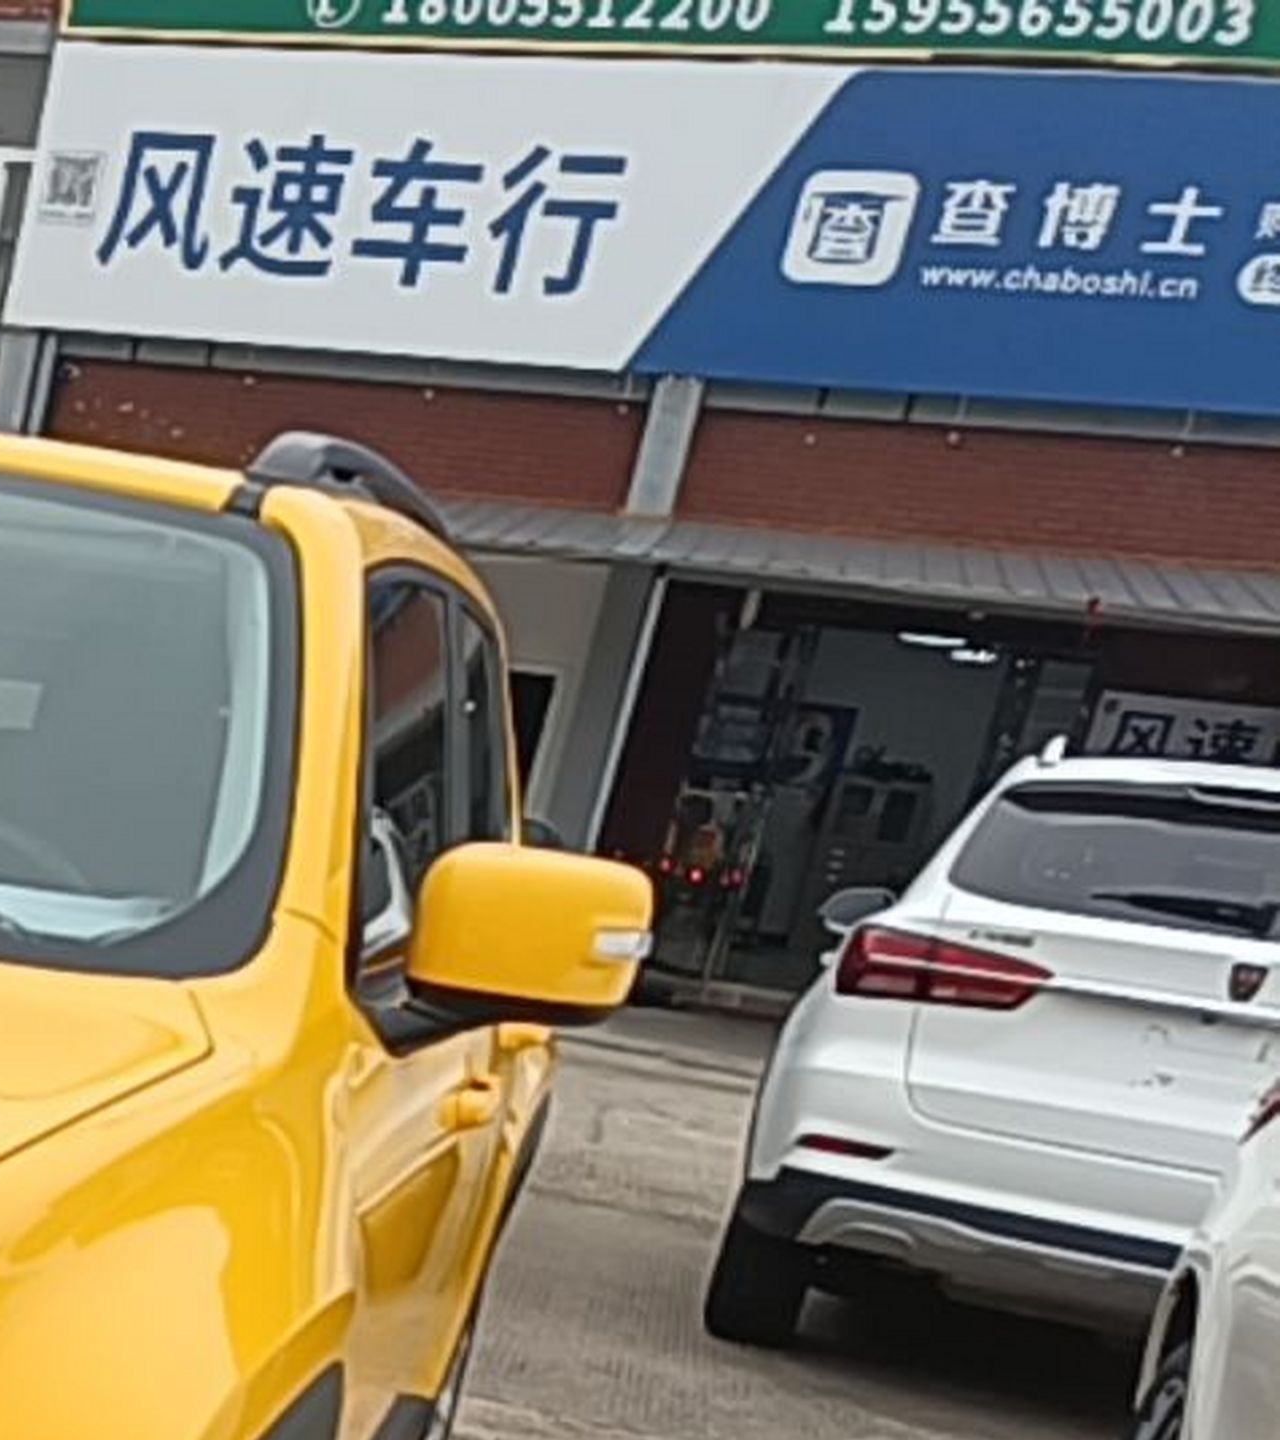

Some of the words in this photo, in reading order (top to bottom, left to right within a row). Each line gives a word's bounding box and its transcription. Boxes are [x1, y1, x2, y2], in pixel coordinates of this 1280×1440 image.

[822, 0, 1256, 46] 15955655003
[97, 131, 628, 297] 风速车行
[928, 179, 1224, 256] 查博士
[918, 263, 1200, 300] www.chaboshi.cn
